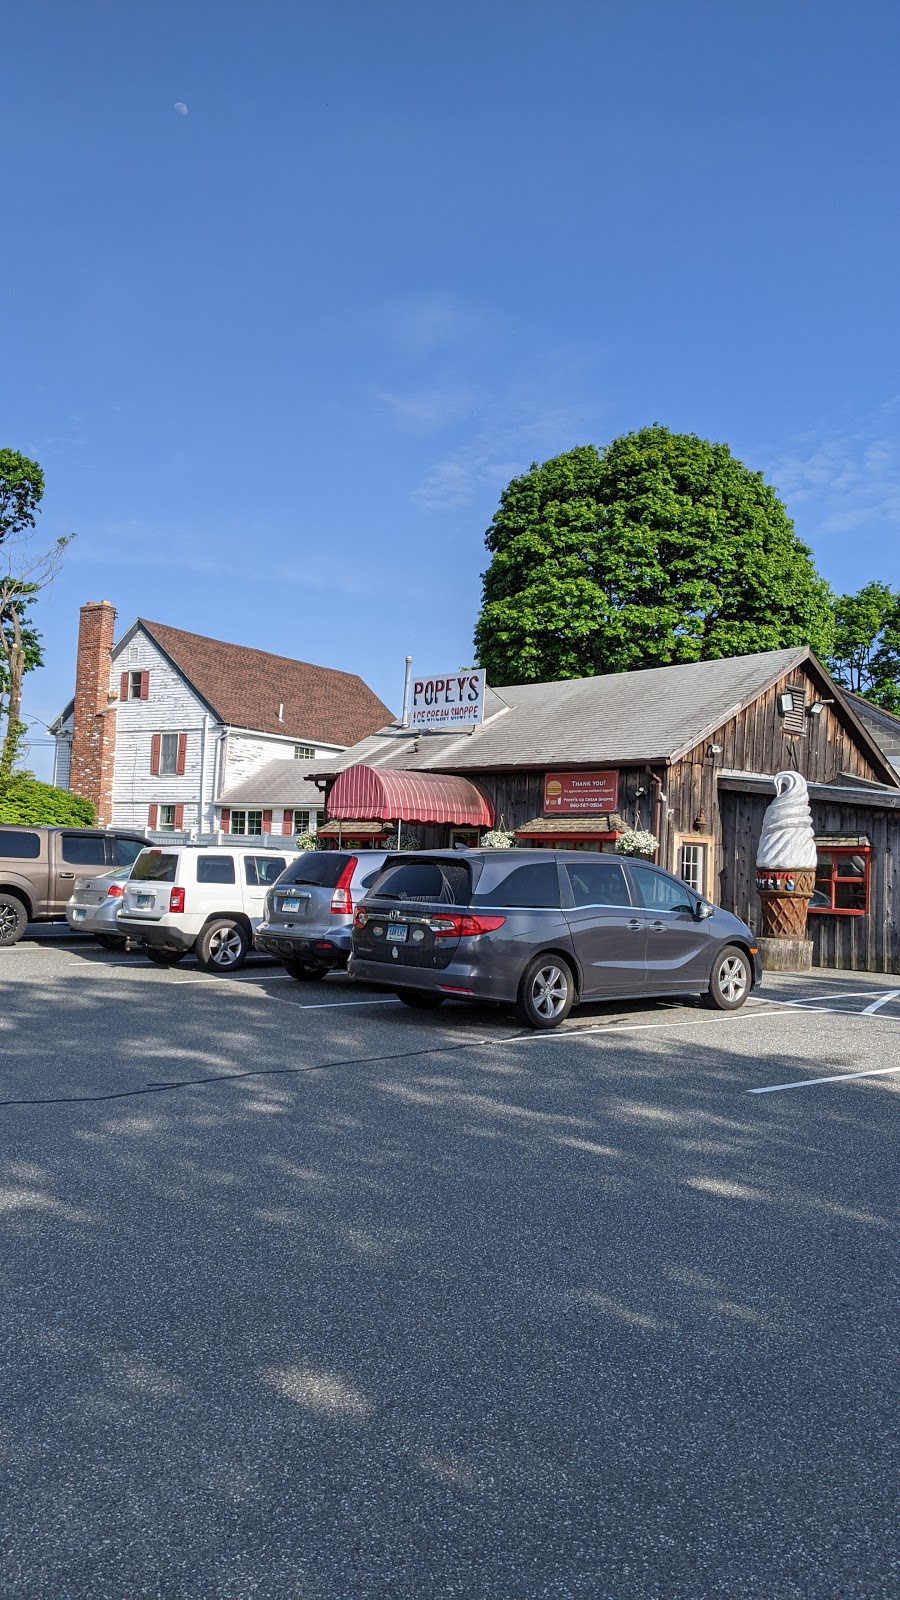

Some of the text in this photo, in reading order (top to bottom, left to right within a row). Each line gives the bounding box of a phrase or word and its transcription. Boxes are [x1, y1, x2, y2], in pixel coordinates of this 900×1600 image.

[413, 675, 479, 706] POPEY'S
[413, 705, 479, 723] ICE CREAM SHOPPE
